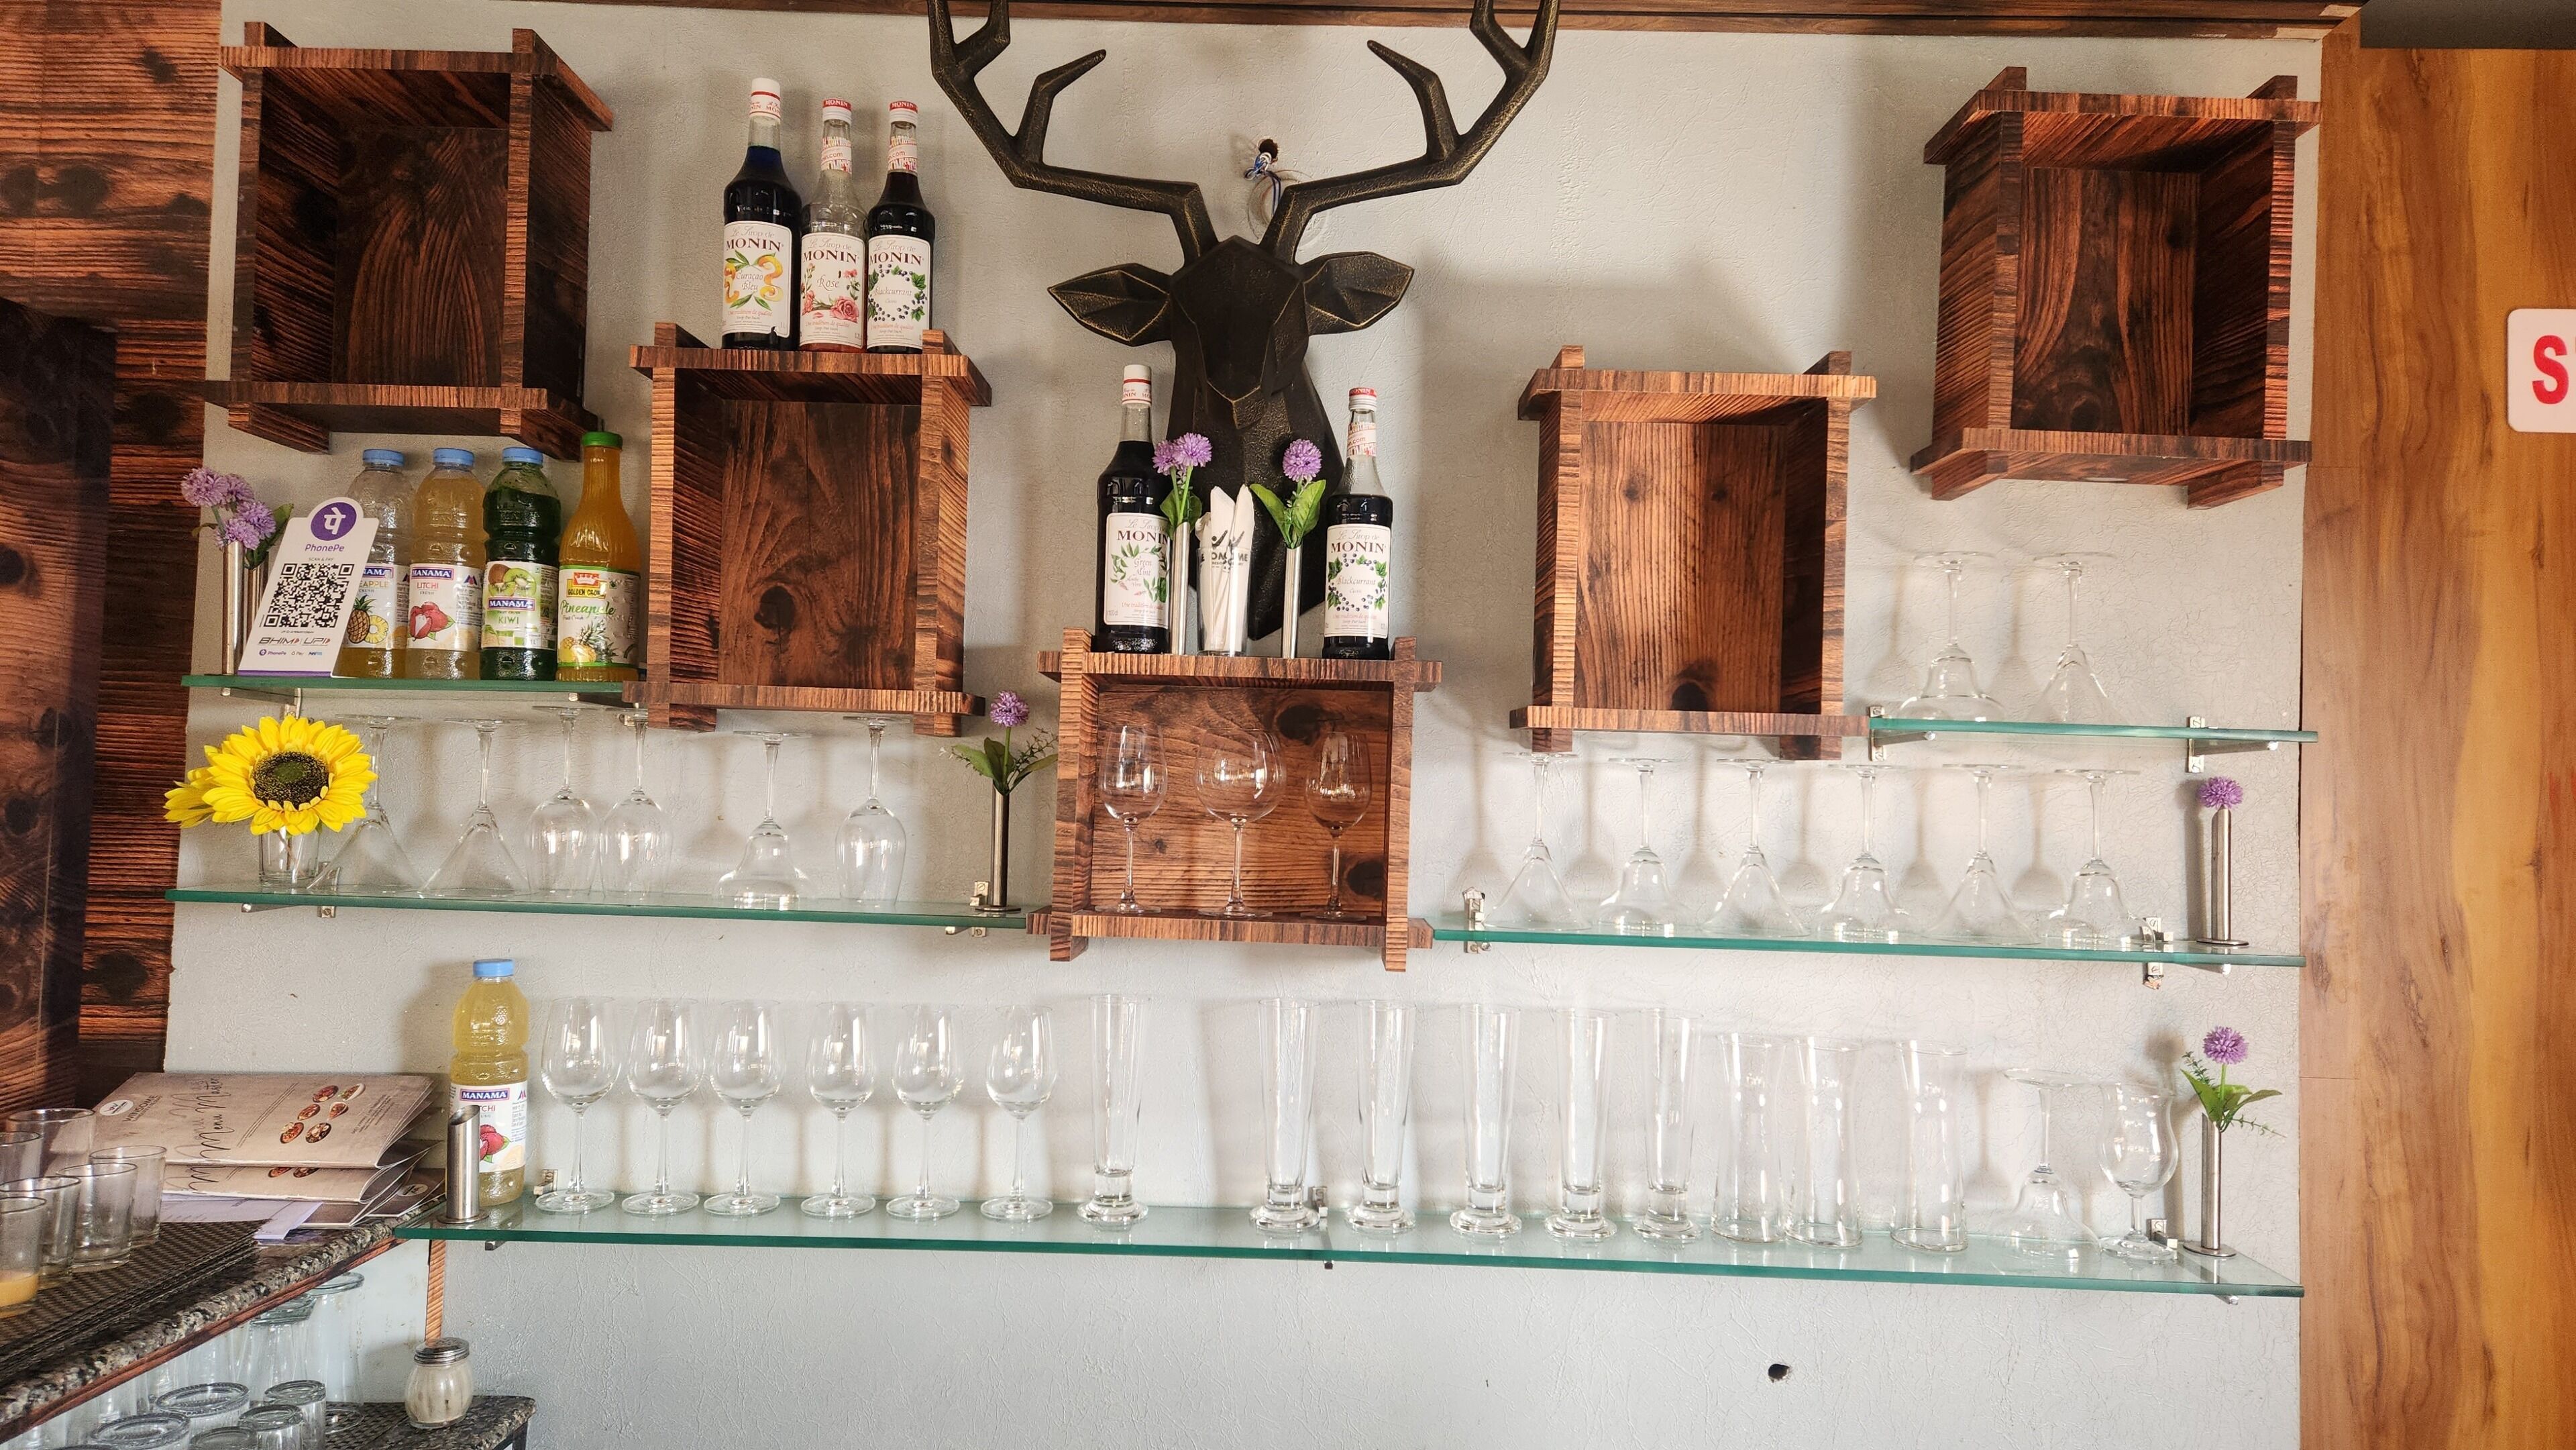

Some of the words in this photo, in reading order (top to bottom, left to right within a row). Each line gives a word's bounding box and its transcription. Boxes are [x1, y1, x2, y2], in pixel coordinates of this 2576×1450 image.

[726, 238, 782, 252] MONIN
[803, 249, 858, 264] MONIN
[869, 251, 922, 266] MONIN
[736, 270, 763, 280] Curaçao
[741, 280, 759, 291] Bleu
[816, 274, 839, 291] Rose
[873, 285, 912, 297] Blackcurrant
[2532, 335, 2576, 405] S
[1116, 530, 1169, 545] MONIN
[305, 543, 345, 552] PhonePe
[1330, 541, 1385, 554] MONIN
[1134, 558, 1152, 568] Green
[412, 568, 451, 577] MANAMA
[1134, 568, 1151, 576] Mint
[1336, 576, 1376, 586] Blackcurrant
[489, 600, 533, 609] MANAMA
[498, 616, 519, 625] KIWI
[462, 1091, 507, 1099] MANAMA
